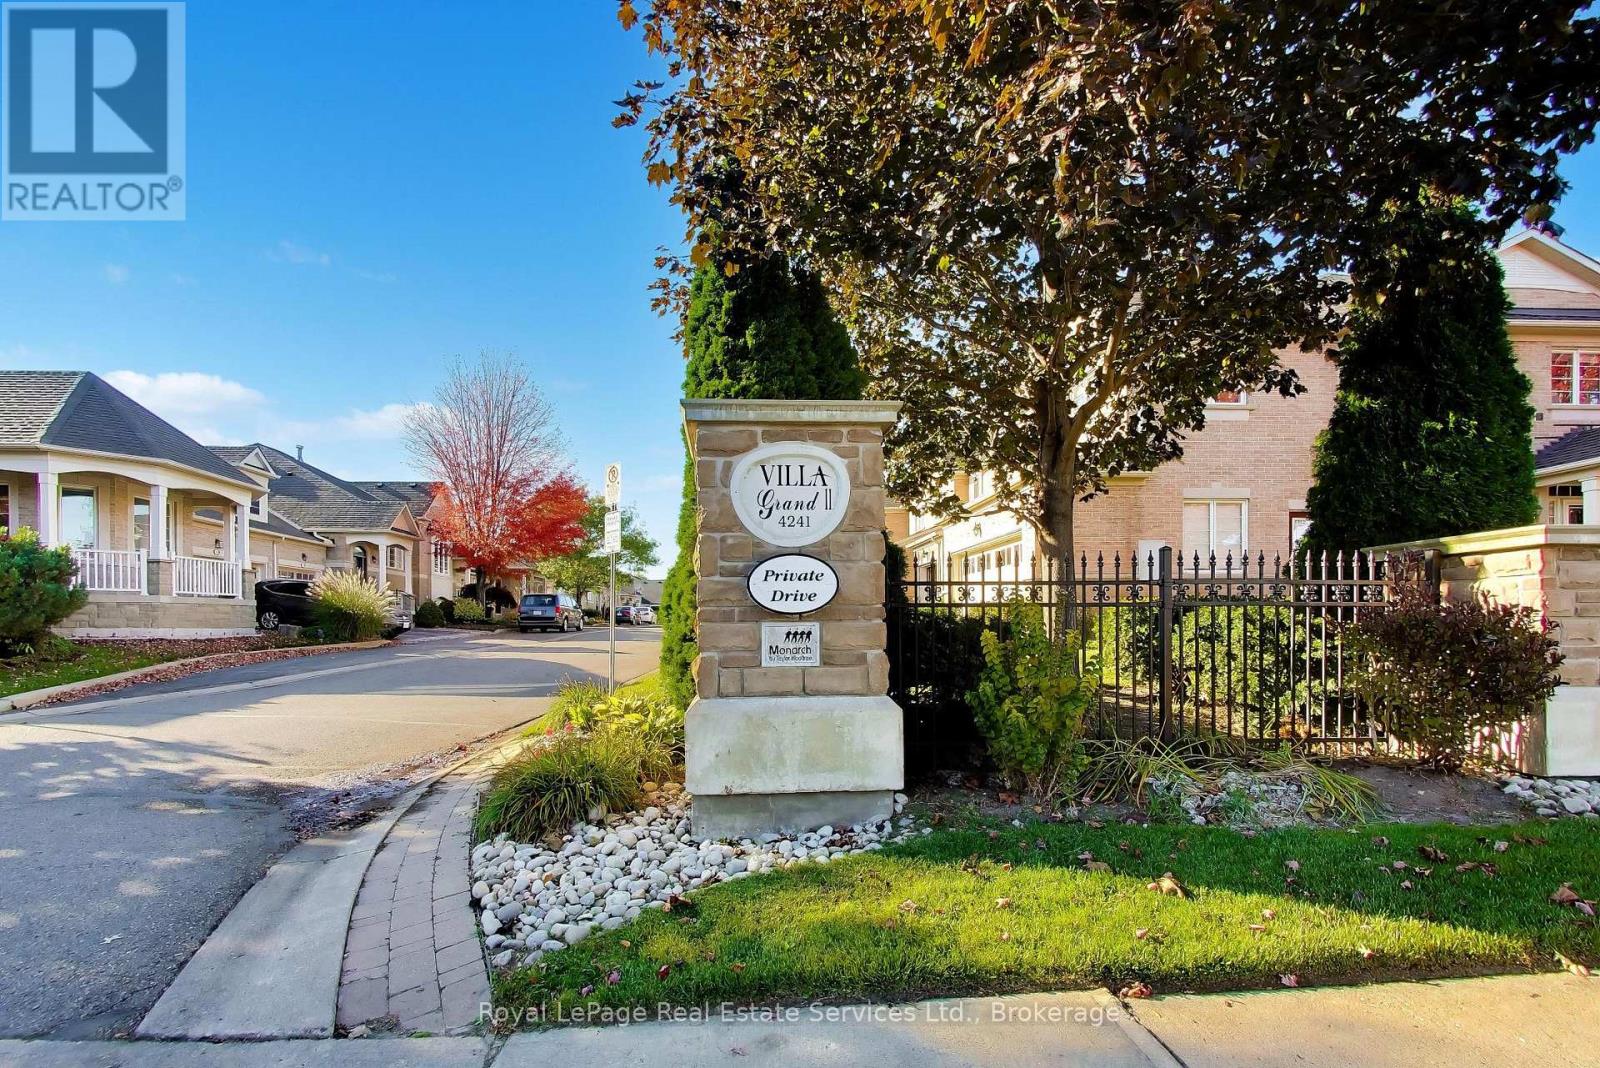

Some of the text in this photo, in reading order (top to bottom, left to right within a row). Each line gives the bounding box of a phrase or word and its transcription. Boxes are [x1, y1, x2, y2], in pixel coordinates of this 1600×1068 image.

[760, 465, 831, 486] VILLA
[757, 489, 819, 519] Grand
[778, 516, 810, 527] 4241
[764, 570, 824, 581] Private
[771, 590, 817, 602] Drive
[769, 645, 812, 655] Monarch
